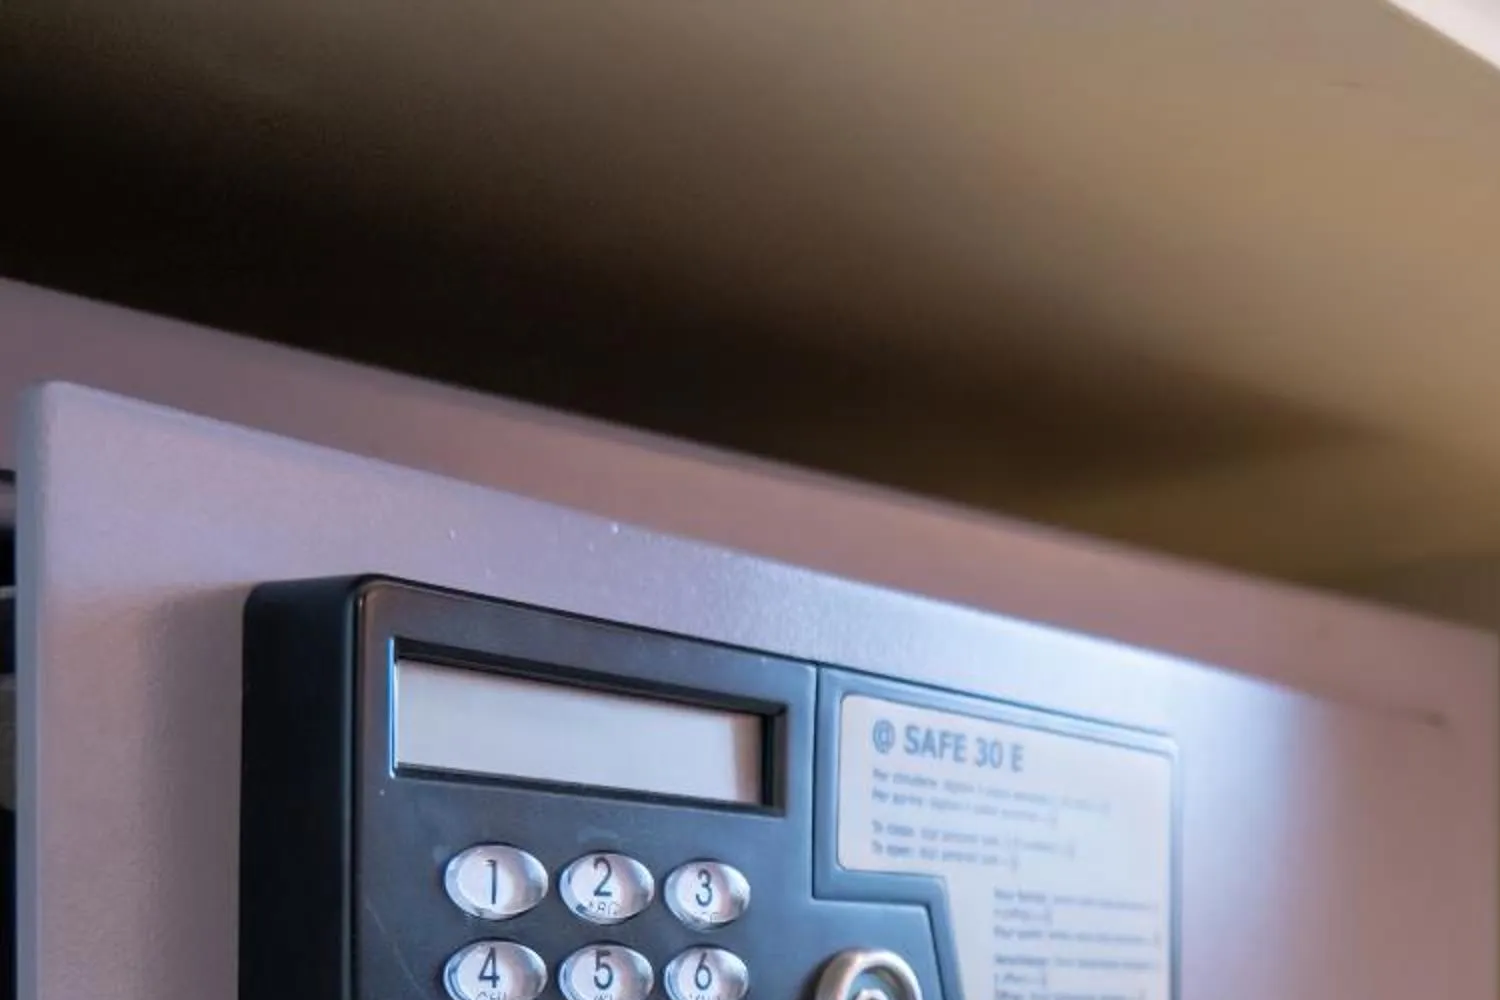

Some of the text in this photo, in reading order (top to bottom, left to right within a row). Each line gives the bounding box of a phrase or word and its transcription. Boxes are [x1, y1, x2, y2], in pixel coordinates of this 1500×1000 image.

[904, 724, 968, 763] SAFE
[975, 737, 1003, 769] 30
[1010, 743, 1024, 773] E
[485, 859, 498, 905] 1
[592, 857, 613, 897] 2
[695, 868, 713, 908] 3
[478, 947, 500, 989] 4
[593, 950, 613, 990] 5
[695, 952, 712, 991] 6
